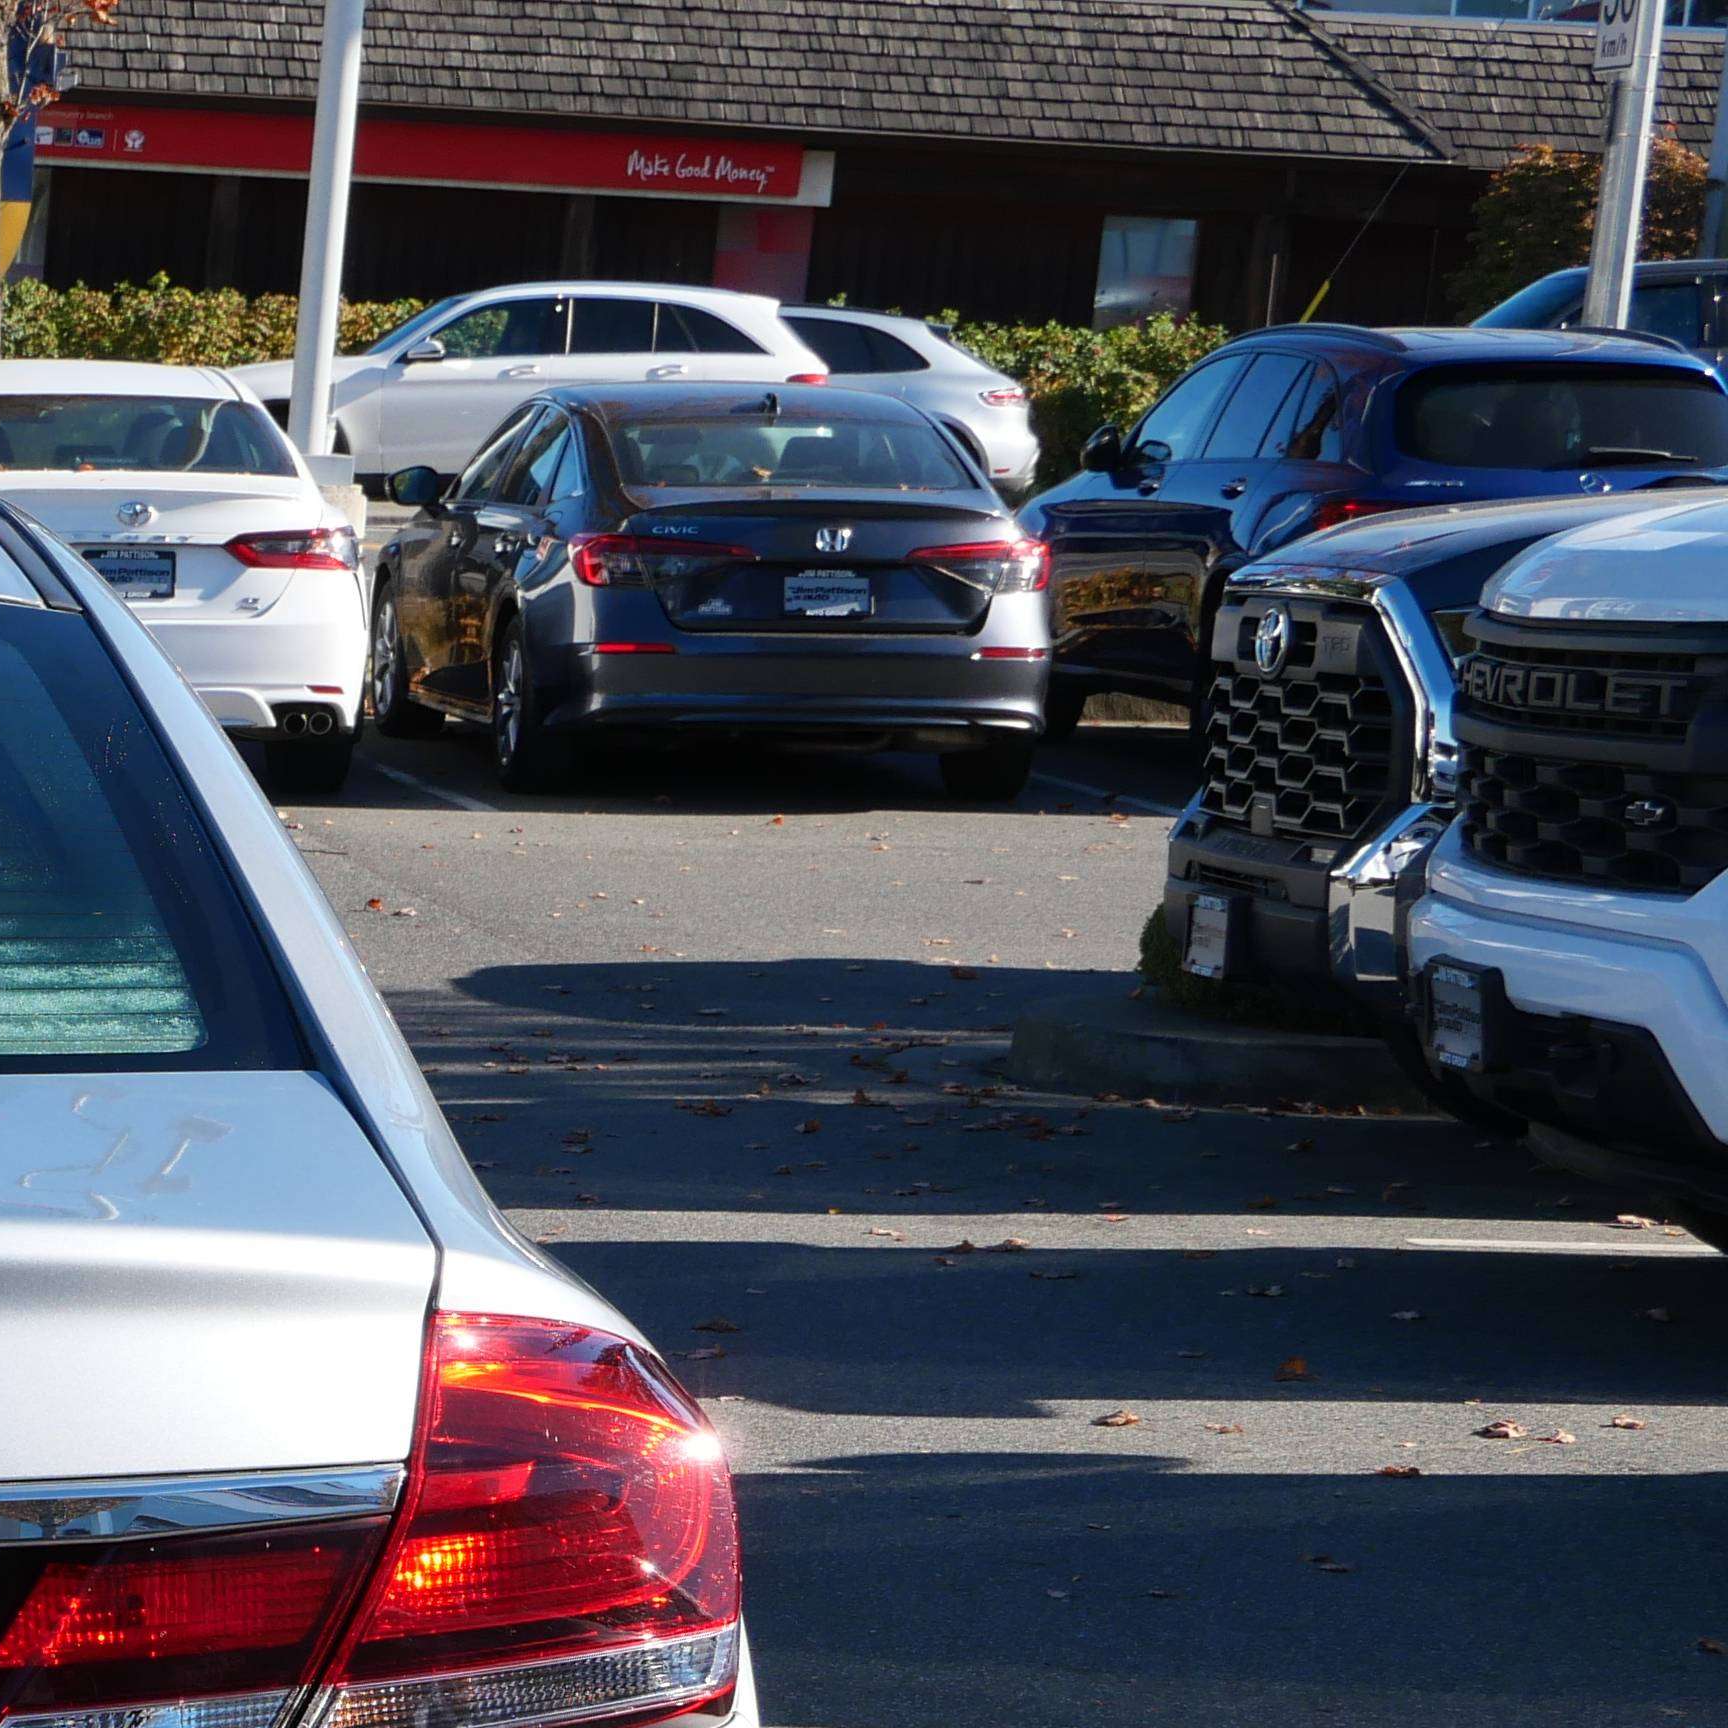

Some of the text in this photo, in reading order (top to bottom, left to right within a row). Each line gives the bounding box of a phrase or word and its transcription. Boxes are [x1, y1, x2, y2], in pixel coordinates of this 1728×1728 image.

[1601, 32, 1627, 57] km/h
[627, 149, 670, 181] Make
[675, 153, 712, 178] Good
[652, 526, 700, 534] CIVIC
[1456, 659, 1688, 717] HEVROLET
